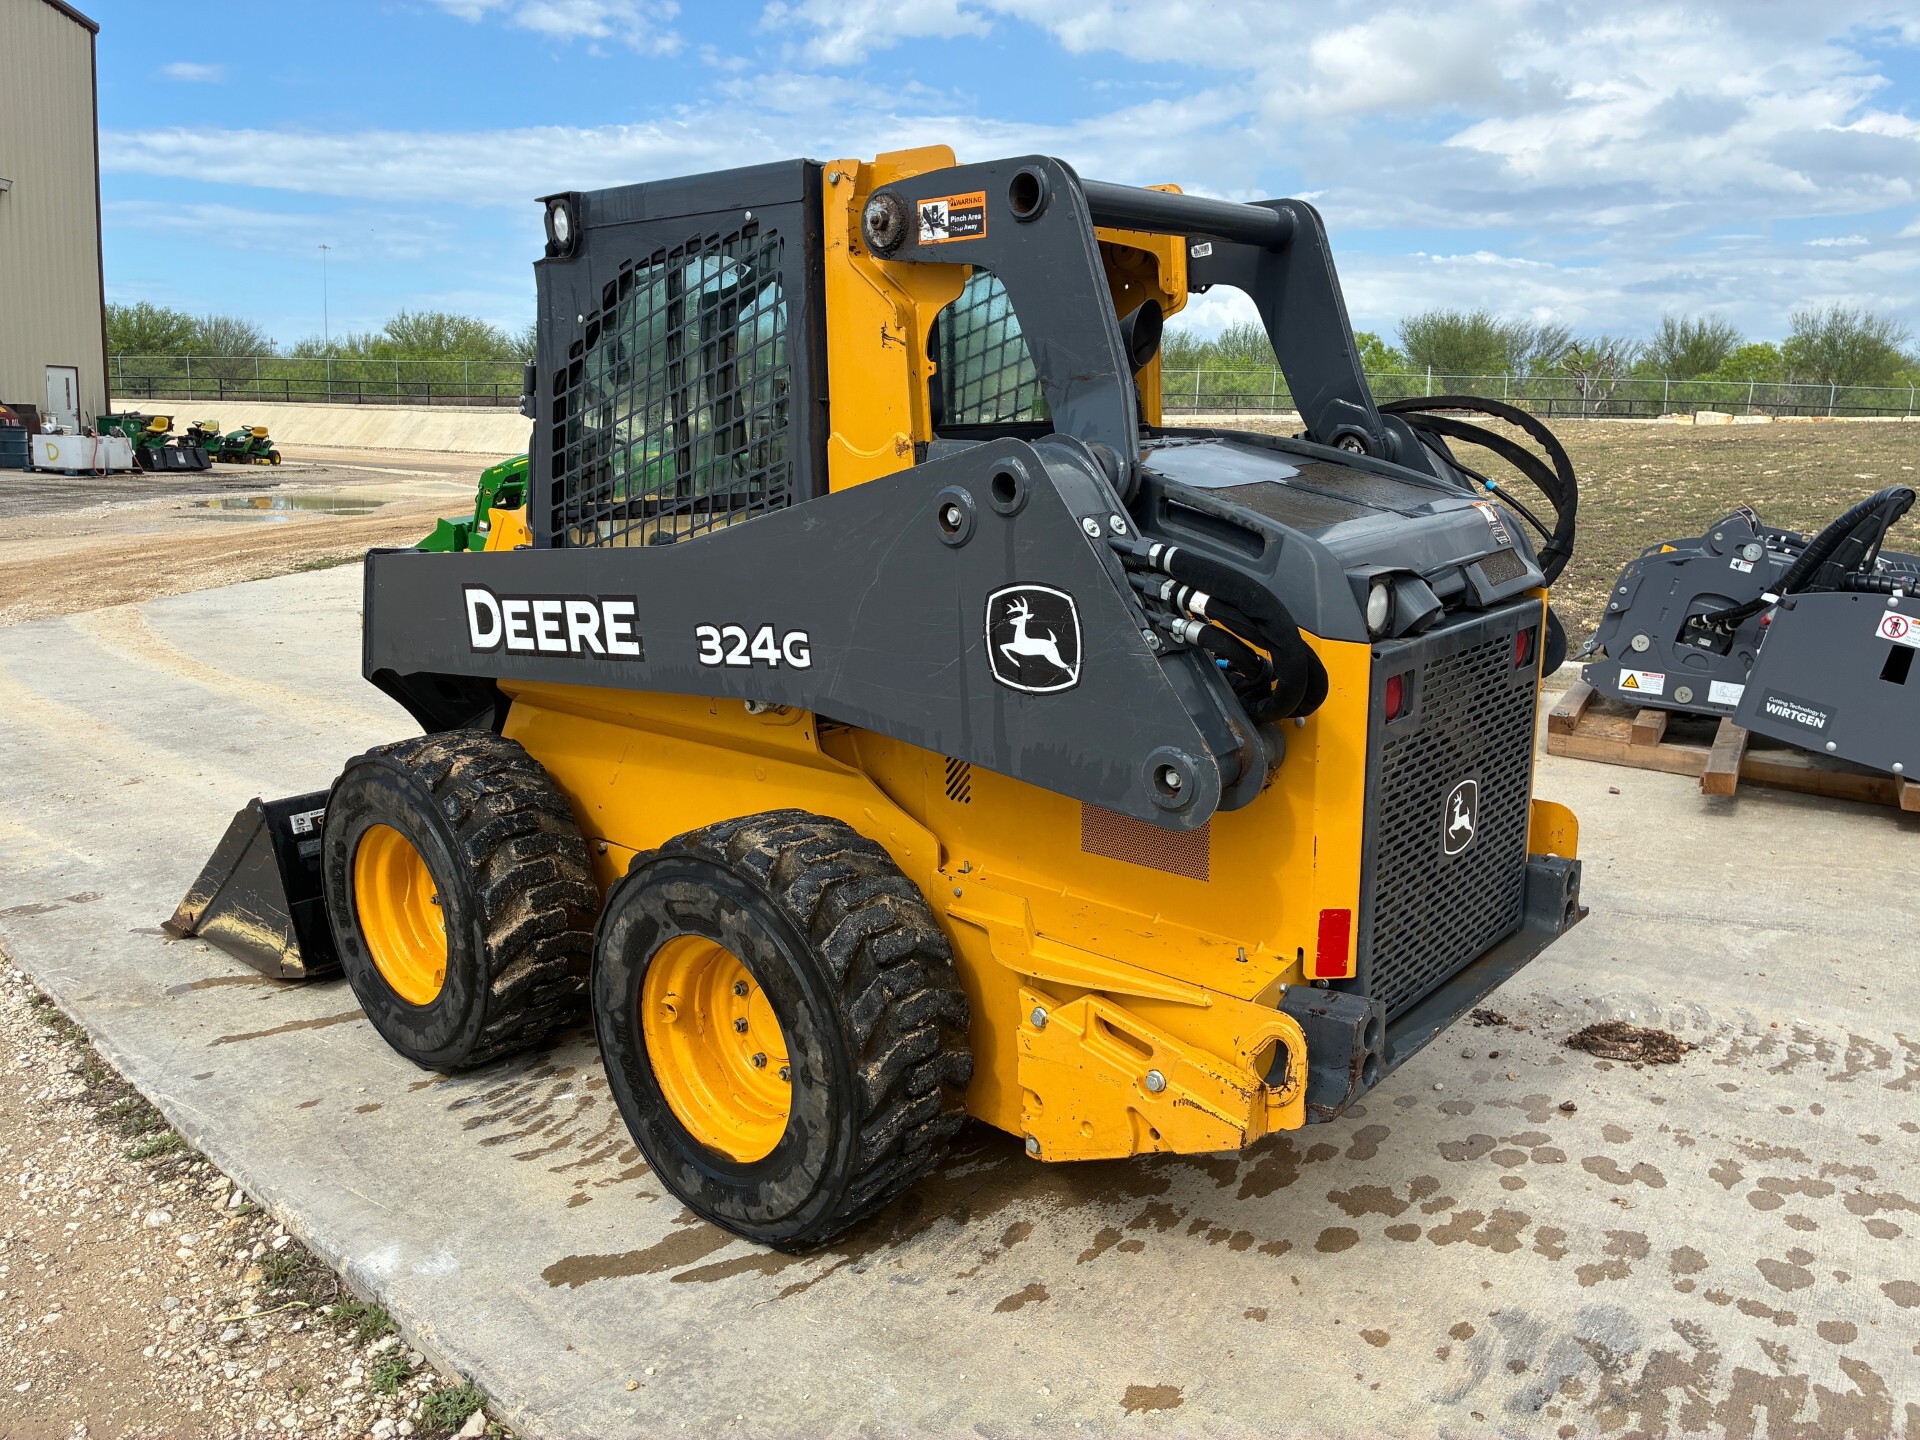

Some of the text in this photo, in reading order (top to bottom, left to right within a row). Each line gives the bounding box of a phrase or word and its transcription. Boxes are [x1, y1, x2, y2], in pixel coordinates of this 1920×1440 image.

[956, 197, 982, 205] WARNING
[950, 214, 967, 223] Pinch
[464, 588, 640, 656] DEERE
[696, 625, 812, 668] 324G
[1766, 702, 1826, 729] WIRTGEN
[1768, 696, 1828, 719] Cutting Technology by
